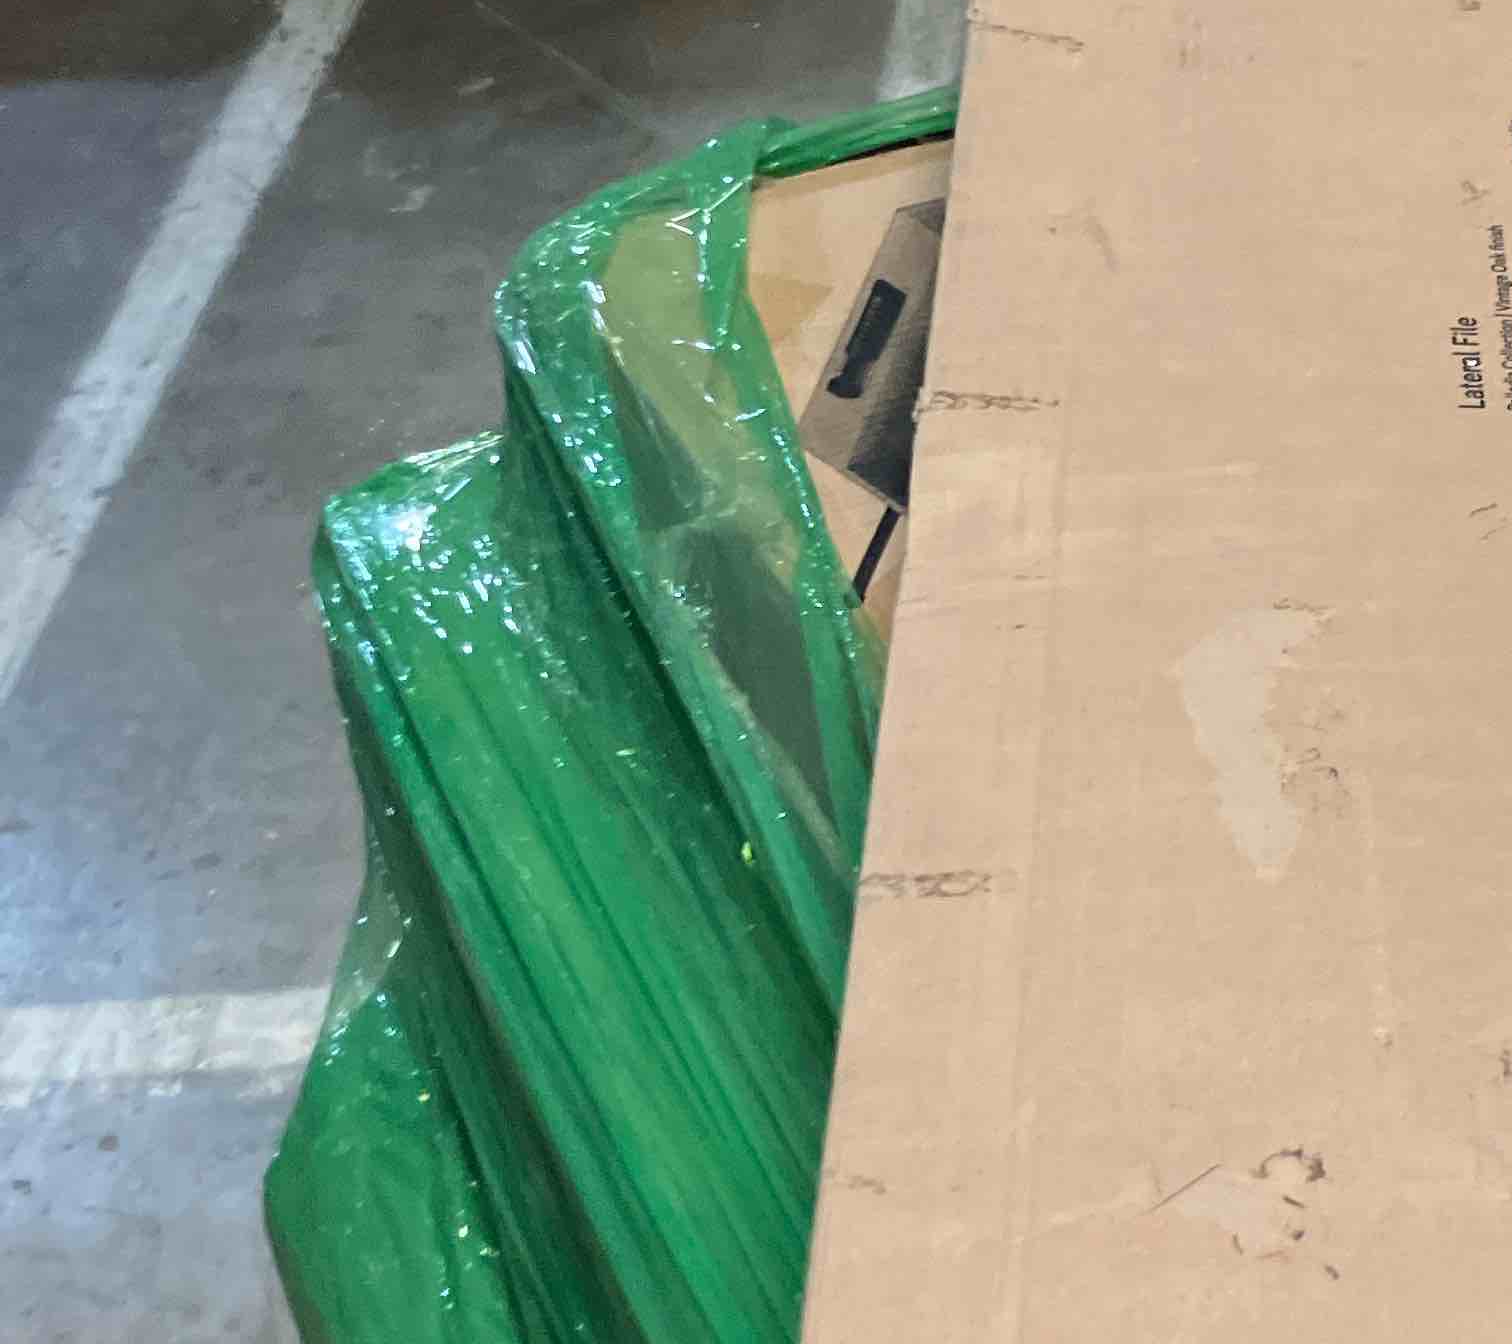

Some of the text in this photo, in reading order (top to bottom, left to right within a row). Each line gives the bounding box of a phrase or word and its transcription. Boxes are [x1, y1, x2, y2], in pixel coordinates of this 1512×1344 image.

[1488, 225, 1504, 250] finish
[1490, 253, 1507, 272] Oak
[1496, 275, 1512, 311] Vintage
[1451, 317, 1485, 408] Lateral File
